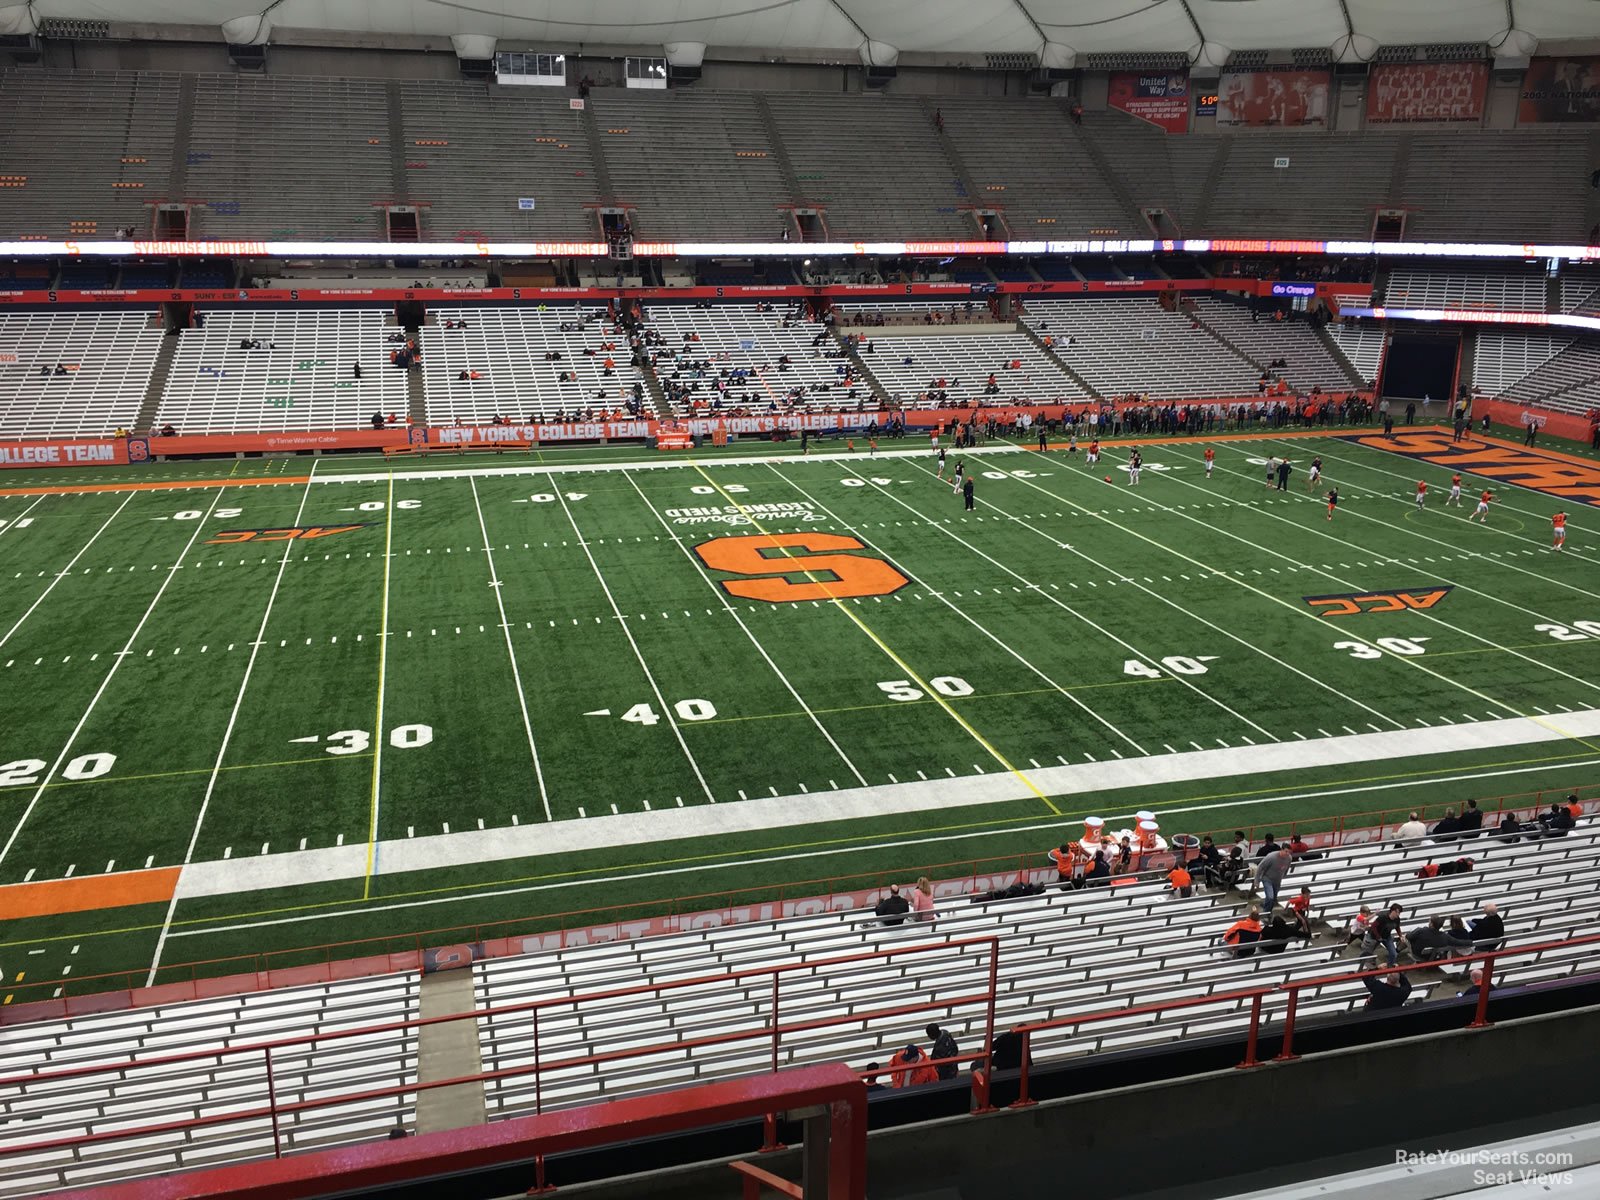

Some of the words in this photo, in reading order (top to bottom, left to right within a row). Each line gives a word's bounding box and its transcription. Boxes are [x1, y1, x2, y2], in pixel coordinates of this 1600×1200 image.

[1140, 78, 1166, 86] United
[1150, 86, 1166, 96] Way
[1552, 91, 1600, 99] NATIONA
[133, 241, 202, 255] SYRACUSE
[206, 241, 269, 255] FOOTBALL
[536, 243, 598, 256] SYRACUSE
[905, 242, 956, 254] SYRACUSE
[1048, 240, 1089, 253] TICKETS
[1212, 240, 1268, 252] SYRACUSE
[1270, 240, 1324, 253] FOOTBALL
[717, 287, 723, 297] S
[906, 285, 912, 294] S
[1083, 282, 1088, 291] S
[1273, 285, 1285, 294] Go
[1286, 285, 1314, 295] Orange
[48, 291, 57, 302] S
[290, 290, 298, 300] S
[513, 289, 520, 298] S
[1444, 310, 1496, 322] SYRACUSE
[1500, 312, 1549, 324] FOOTBALL
[688, 420, 720, 434] NEW
[722, 417, 774, 433] YORK'S
[778, 414, 838, 432] COLLEGE
[842, 412, 878, 428] TEAM
[439, 428, 474, 443] NEW
[478, 426, 534, 442] YORK'S
[538, 424, 604, 440] COLLEGE
[608, 422, 650, 438] TEAM
[64, 444, 114, 462] TEAM
[129, 441, 148, 461] S
[982, 470, 1037, 480] 30
[840, 477, 893, 487] 40
[690, 484, 750, 495] 50
[530, 492, 588, 503] 40
[360, 499, 422, 511] 30
[723, 502, 816, 514] LEGENDS
[172, 508, 243, 521] 20
[664, 507, 722, 518] FIELD
[752, 510, 827, 523] Ernie
[673, 515, 754, 528] Davis
[202, 522, 386, 545] ACC
[690, 531, 910, 604] S
[1302, 585, 1456, 618] ACC
[1333, 638, 1426, 660] 30
[1124, 655, 1209, 679] 40
[876, 675, 976, 702] 50
[620, 698, 718, 726] 40
[326, 724, 434, 755] 30
[0, 752, 118, 787] 20
